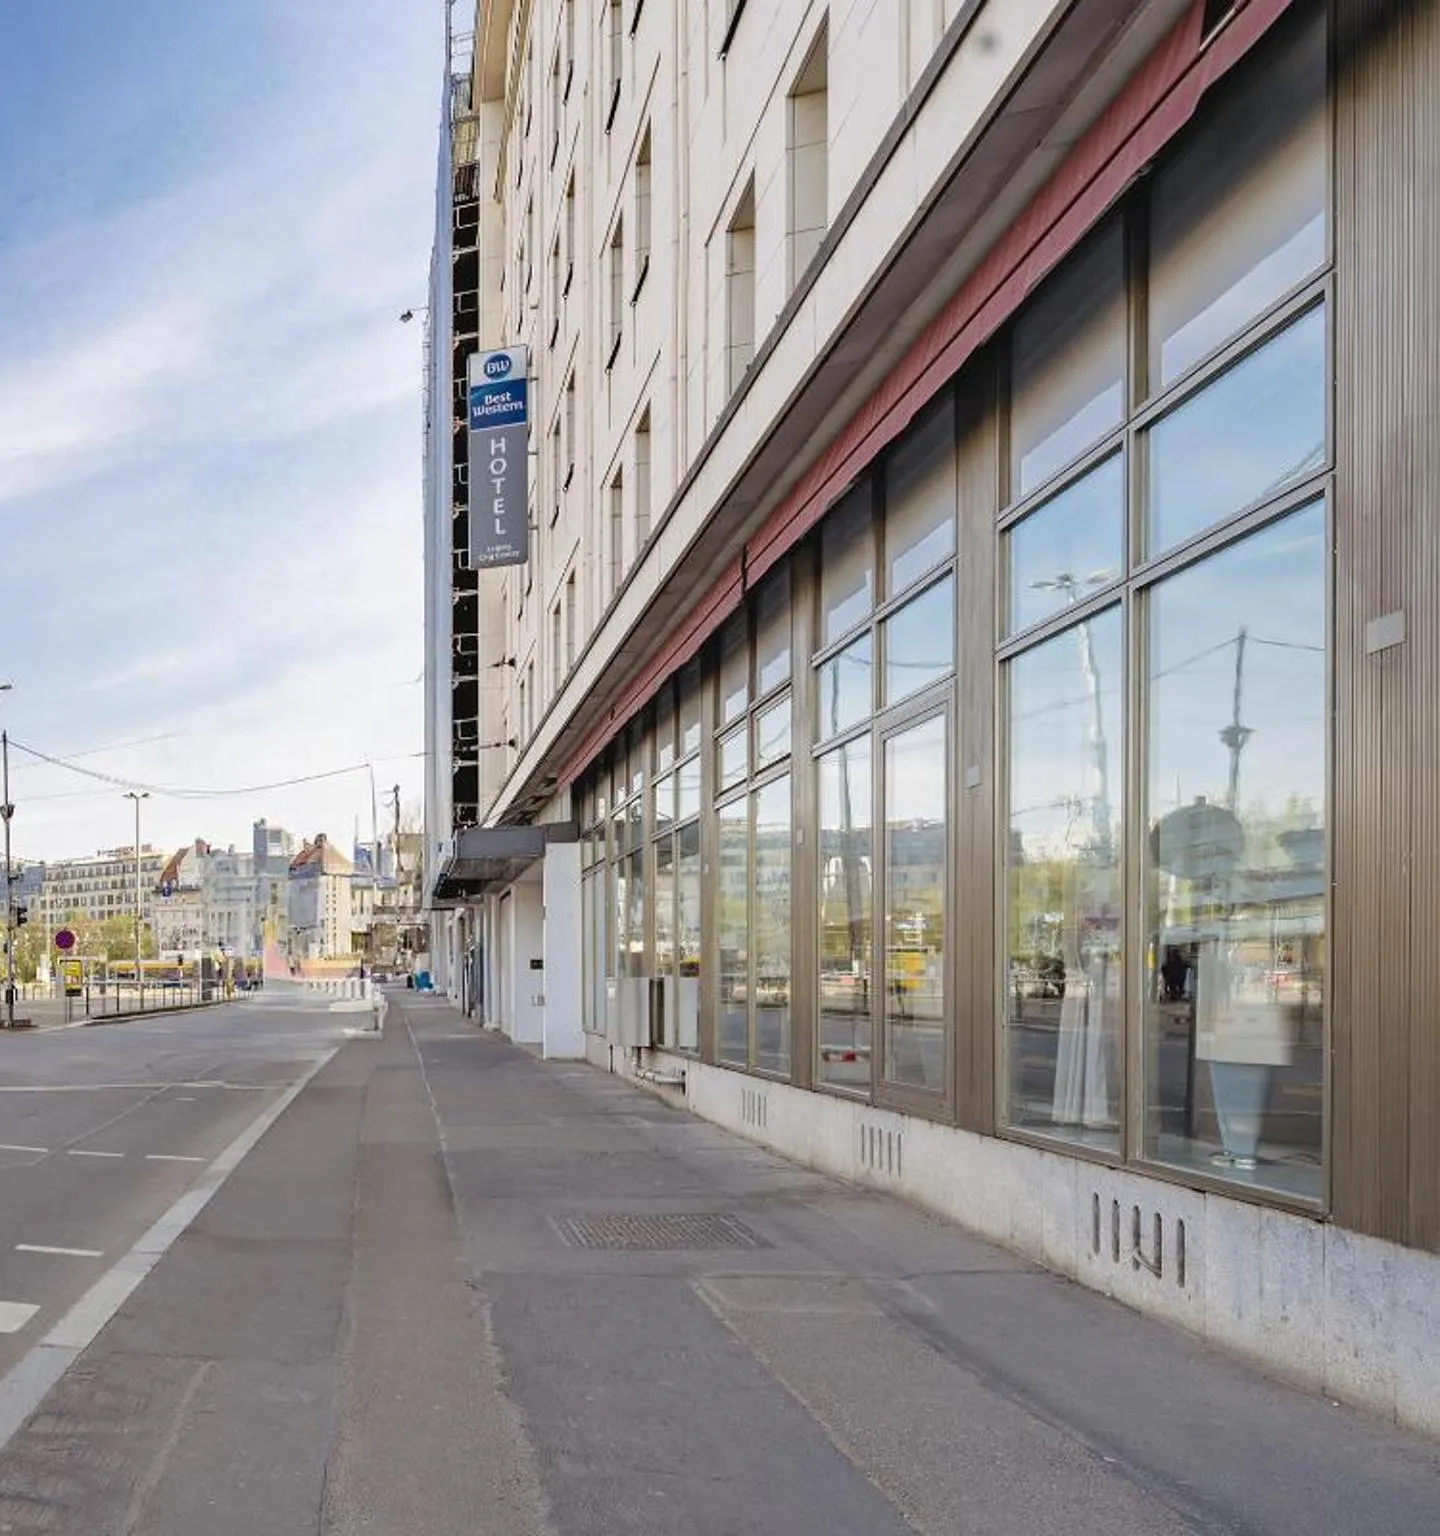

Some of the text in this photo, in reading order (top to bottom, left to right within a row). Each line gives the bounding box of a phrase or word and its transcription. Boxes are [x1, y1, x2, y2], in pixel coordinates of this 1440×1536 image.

[485, 391, 512, 405] Best
[472, 401, 524, 417] Western
[490, 437, 508, 535] HOTEL
